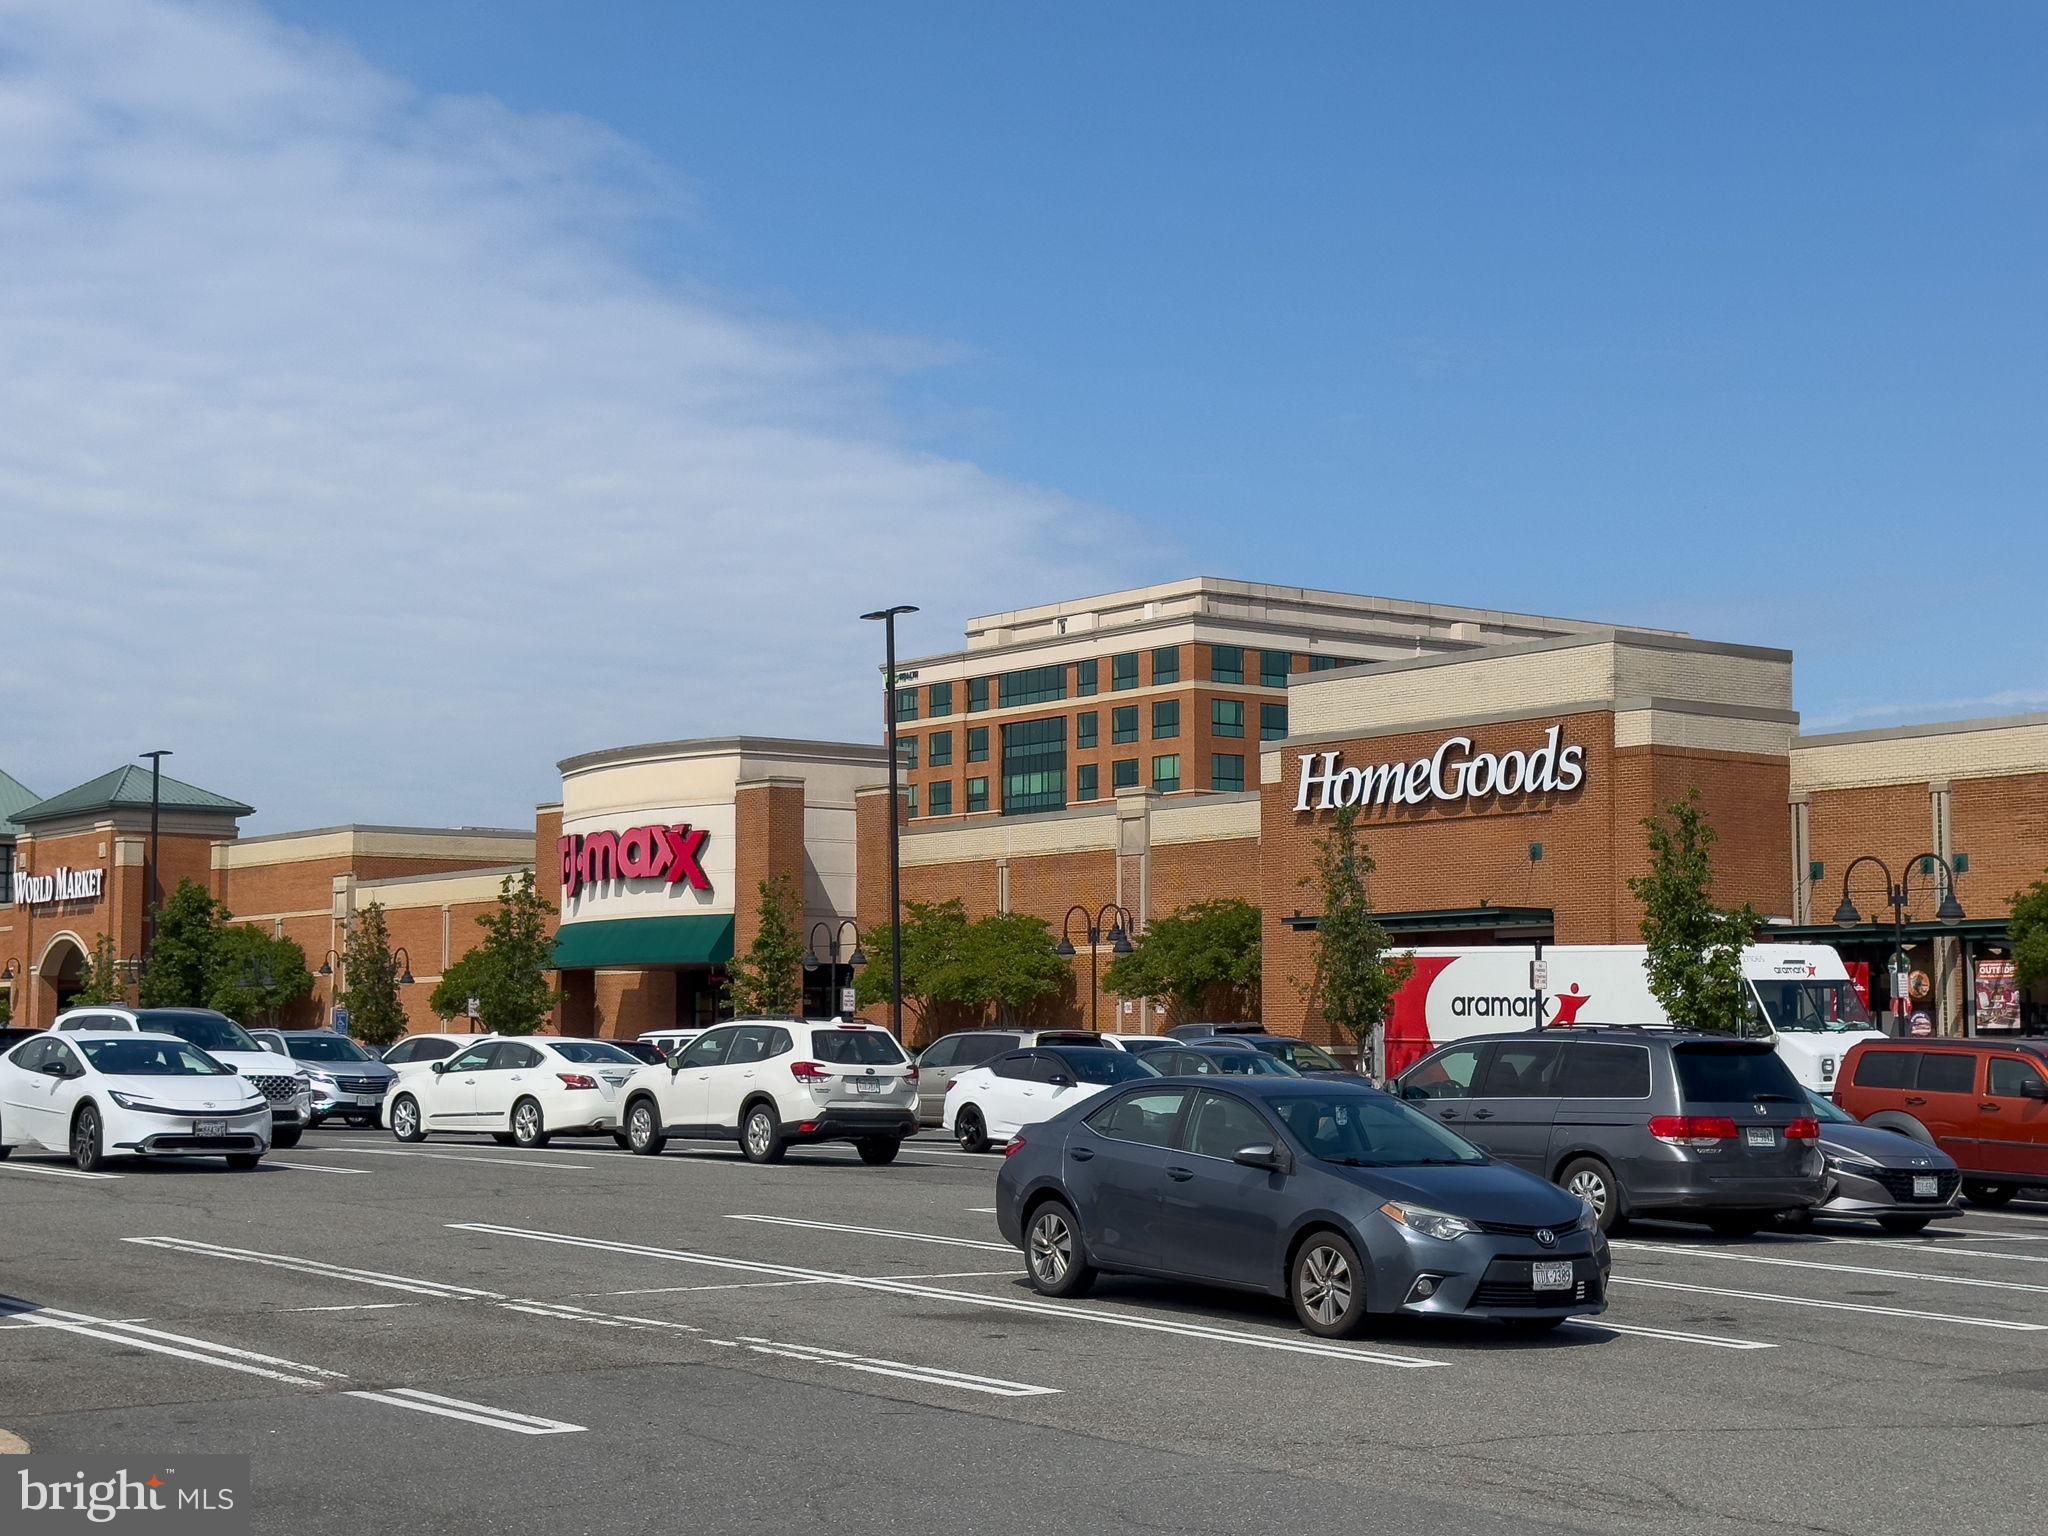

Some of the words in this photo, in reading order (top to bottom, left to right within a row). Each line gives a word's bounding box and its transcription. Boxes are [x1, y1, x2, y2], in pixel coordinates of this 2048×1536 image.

[1293, 725, 1584, 812] HomeGoods
[15, 871, 53, 904] WORLD
[55, 866, 103, 900] MARKET
